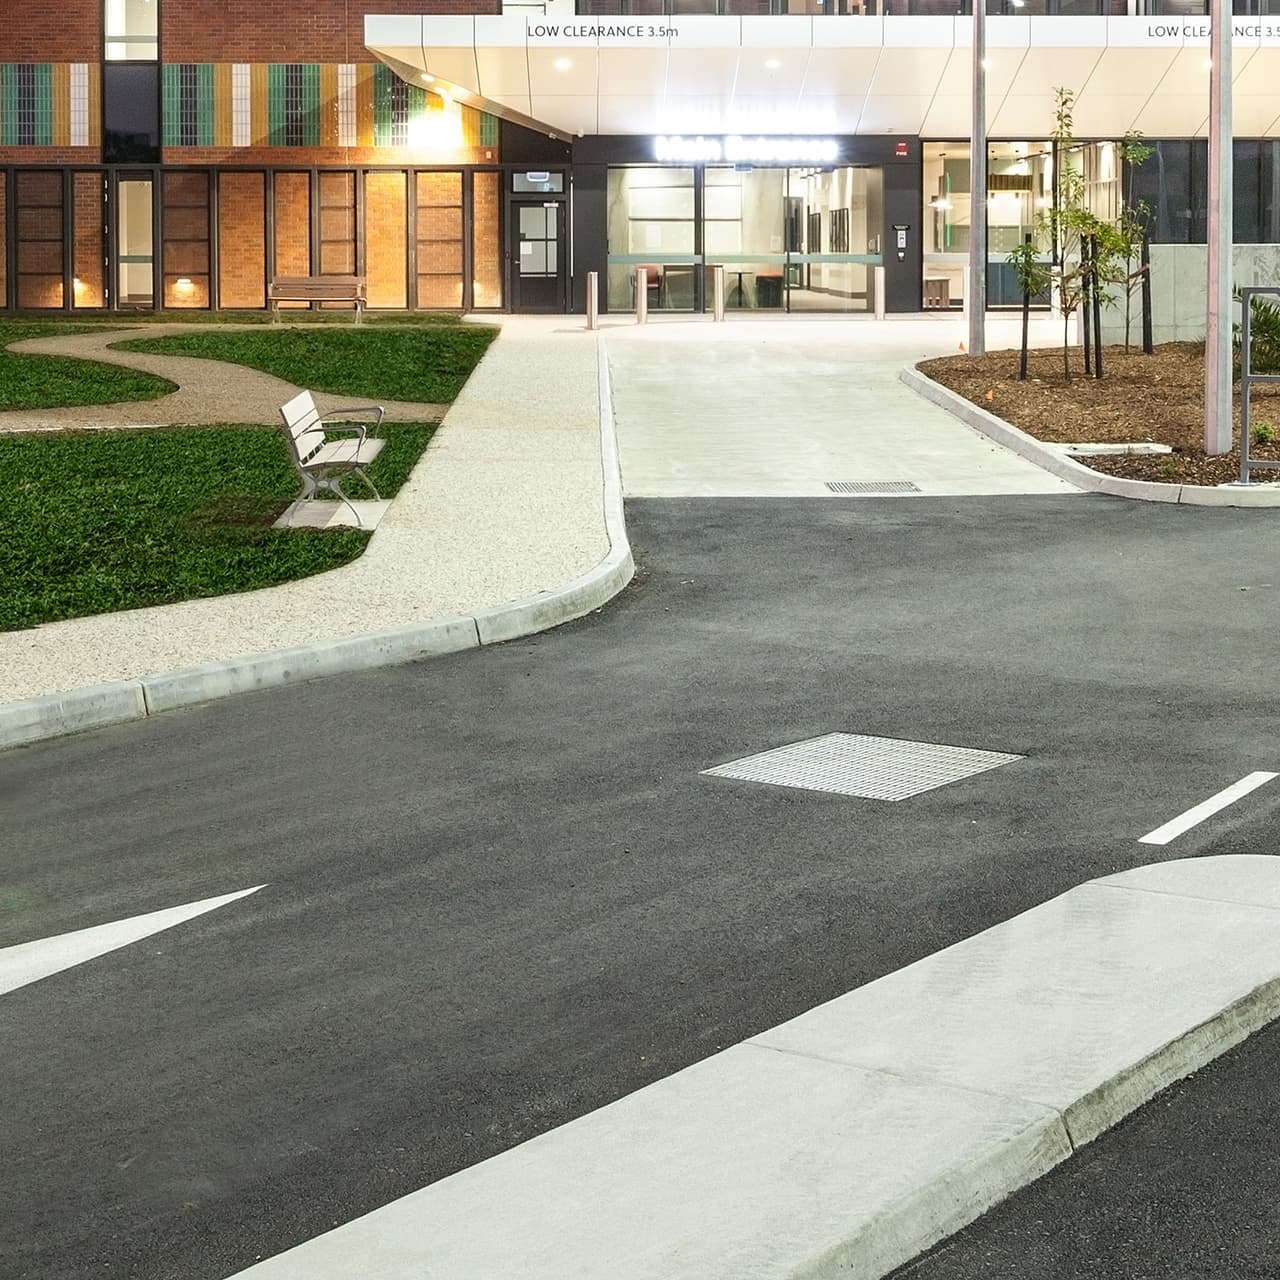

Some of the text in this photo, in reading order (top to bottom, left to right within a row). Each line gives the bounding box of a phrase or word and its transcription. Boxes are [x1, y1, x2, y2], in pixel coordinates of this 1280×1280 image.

[527, 25, 679, 37] LOW CLEARANCE 3.5m
[1147, 25, 1180, 37] LOW
[1182, 25, 1262, 37] CLENCE
